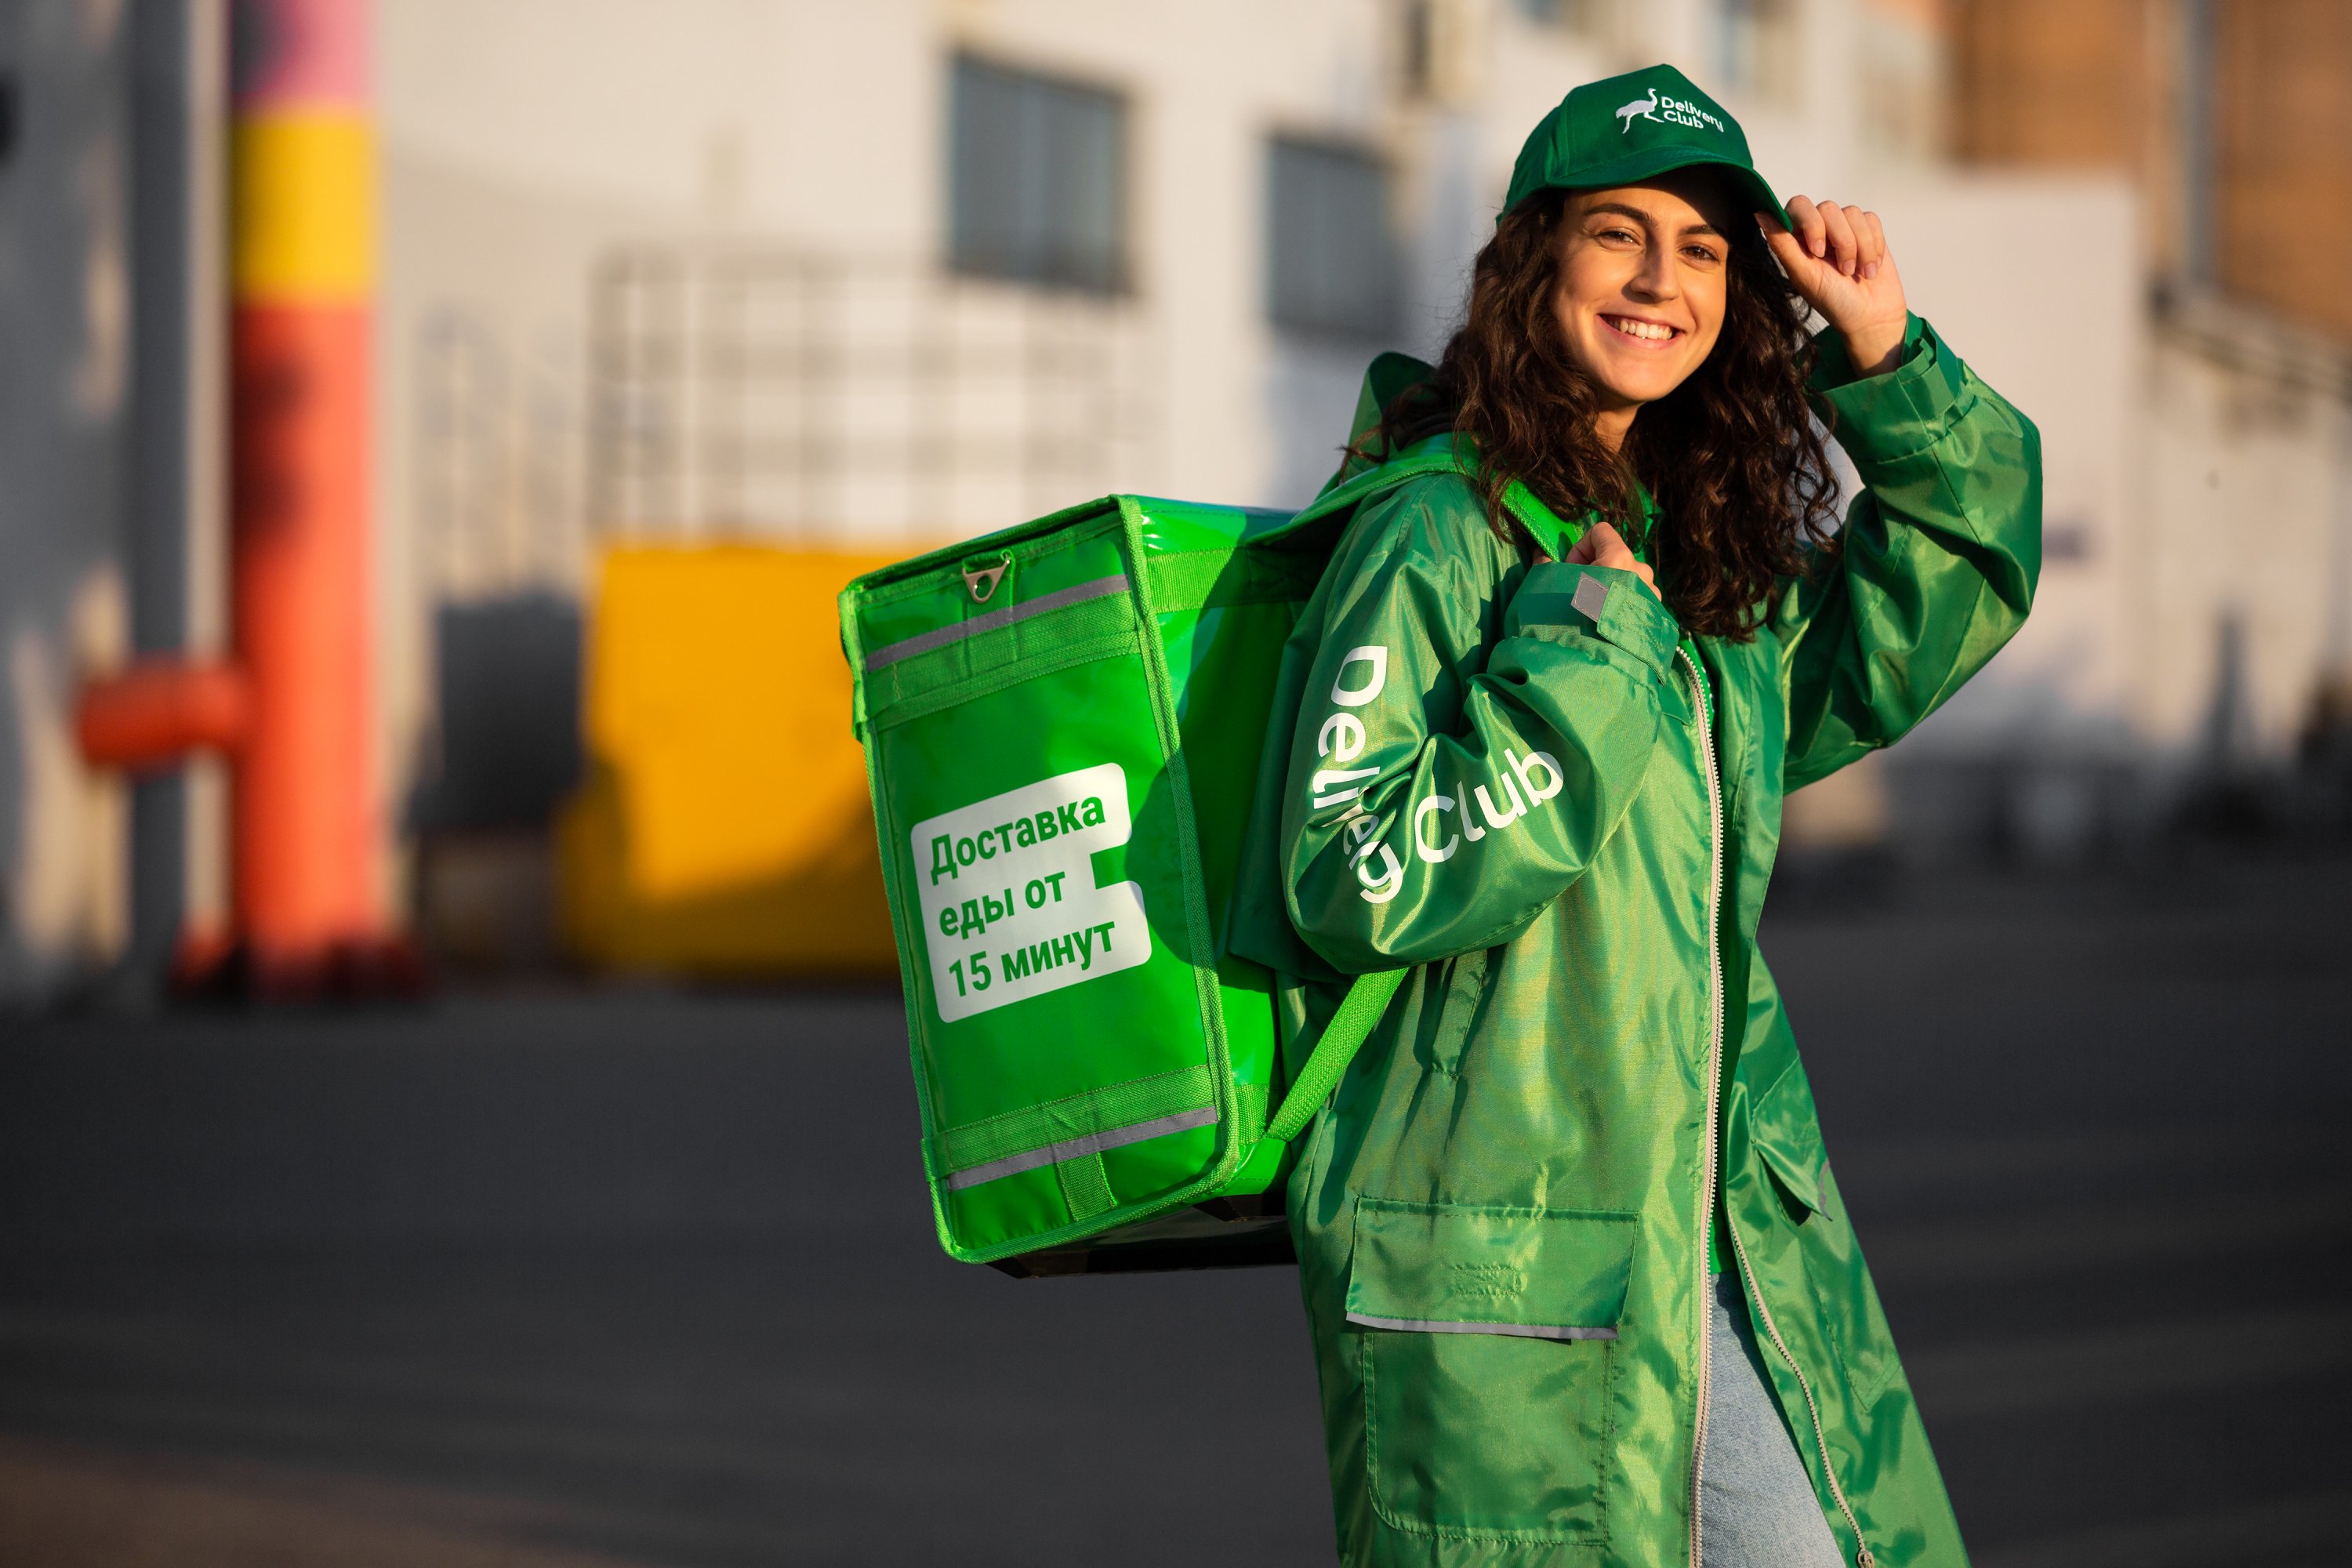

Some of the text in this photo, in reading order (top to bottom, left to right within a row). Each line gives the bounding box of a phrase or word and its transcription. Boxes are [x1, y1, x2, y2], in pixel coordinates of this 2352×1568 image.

[1661, 96, 1724, 132] Delivery
[1663, 111, 1704, 129] Club
[931, 796, 1106, 887] Доставка
[1414, 748, 1564, 863] Club
[938, 871, 1065, 940] еды от
[949, 920, 1116, 997] 15 минут
